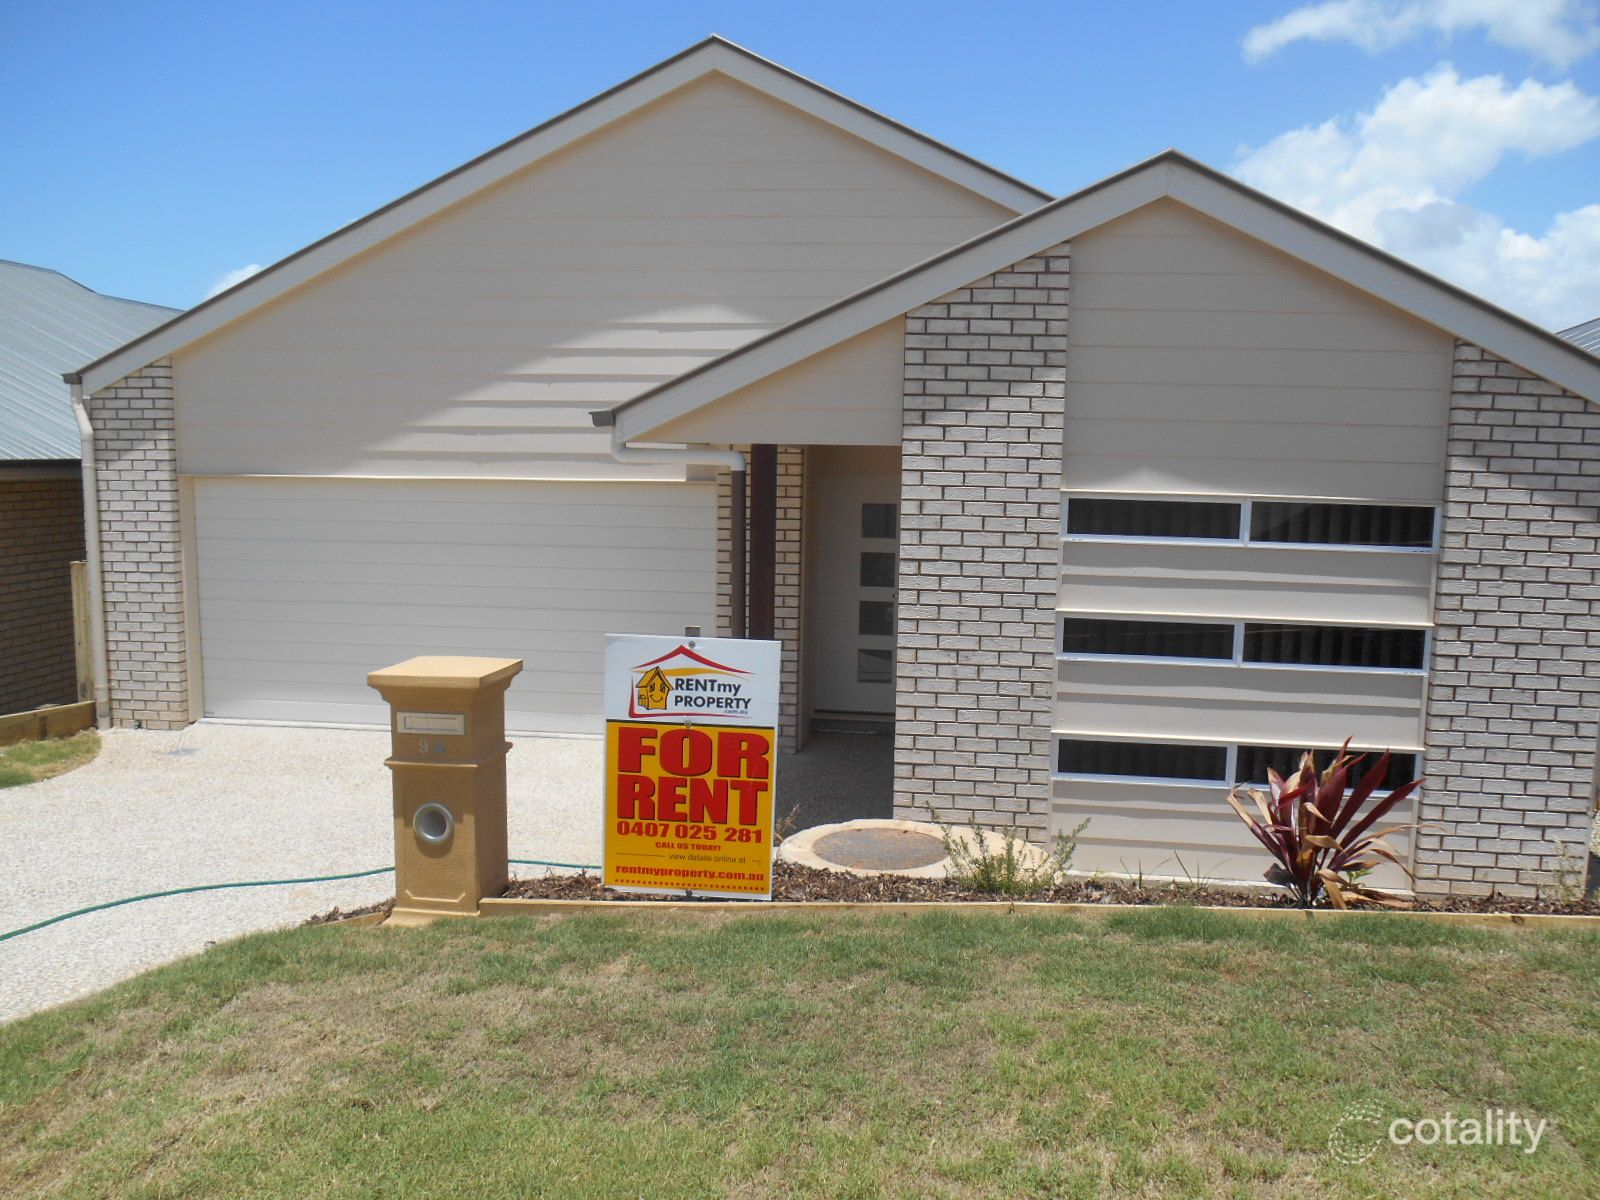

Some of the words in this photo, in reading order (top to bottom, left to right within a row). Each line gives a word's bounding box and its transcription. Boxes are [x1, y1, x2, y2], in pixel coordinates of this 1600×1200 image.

[675, 678, 741, 697] RENTmy
[674, 695, 751, 709] PROPERTY
[618, 727, 770, 780] FOR
[617, 774, 769, 826] RENT
[616, 821, 670, 838] 0407
[675, 824, 717, 840] 025
[724, 827, 762, 844] 281
[655, 842, 675, 850] CALL
[677, 842, 689, 850] US
[691, 843, 721, 852] TODAY!
[669, 853, 686, 861] view
[688, 853, 712, 862] details
[714, 855, 737, 864] online
[616, 865, 764, 881] rentmyproperty.com.au
